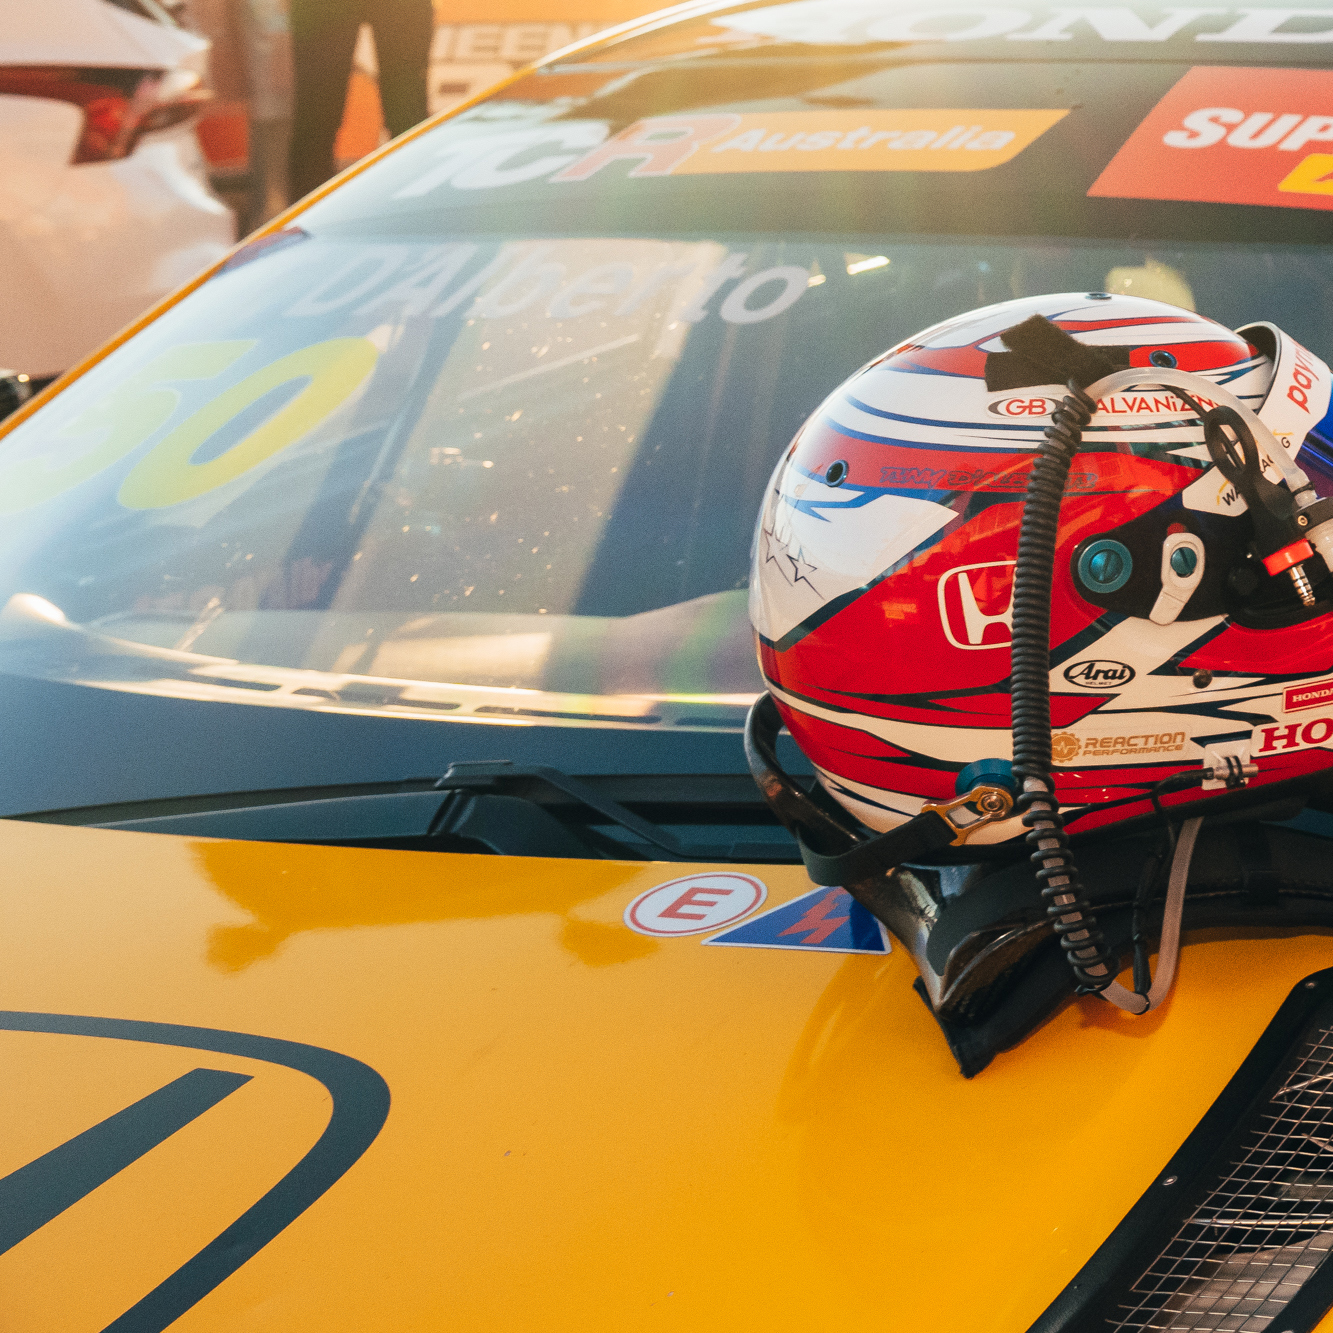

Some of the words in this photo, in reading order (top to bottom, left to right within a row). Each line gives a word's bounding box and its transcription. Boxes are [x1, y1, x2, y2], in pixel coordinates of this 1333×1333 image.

[712, 126, 1015, 156] Australia
[1005, 398, 1047, 416] GB
[1068, 662, 1128, 681] Arai
[1084, 731, 1187, 749] REACTION
[1083, 743, 1185, 757] PERFORMANCE
